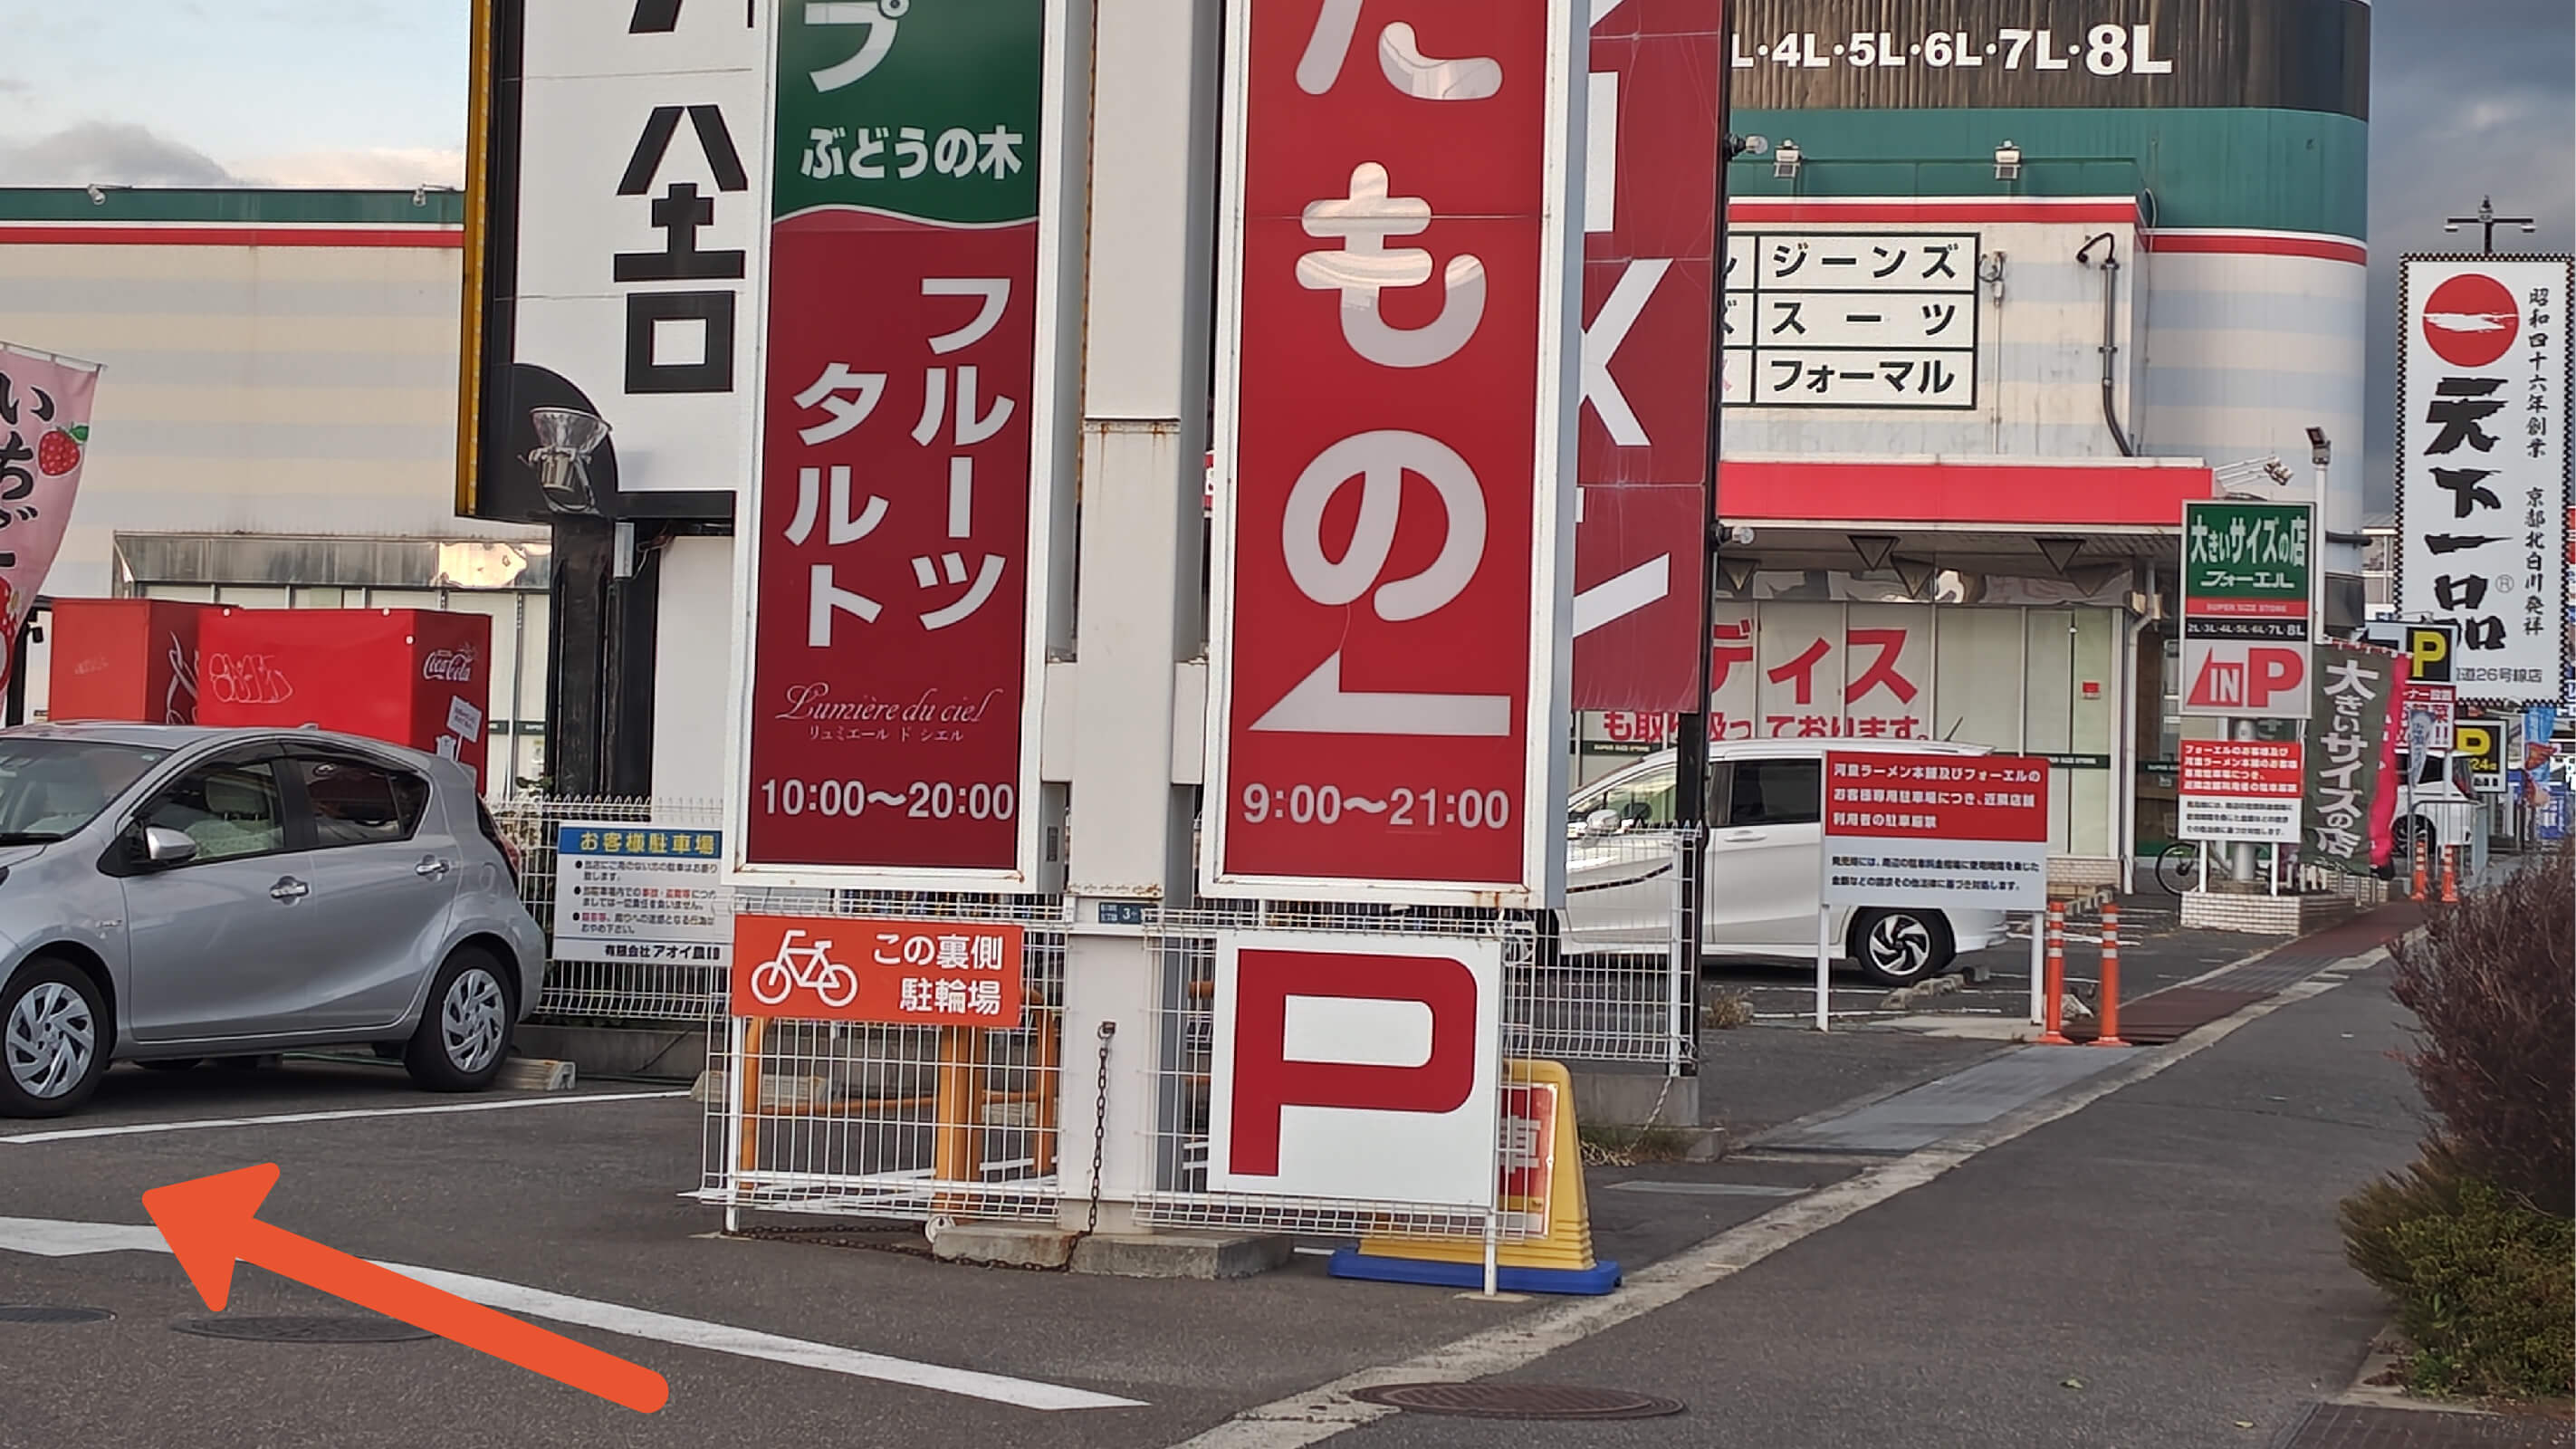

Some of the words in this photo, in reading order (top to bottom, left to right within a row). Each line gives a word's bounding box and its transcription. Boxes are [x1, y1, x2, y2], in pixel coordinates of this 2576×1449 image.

[800, 125, 1024, 179] ぶどうの木
[1772, 242, 1958, 279] ジーンズ
[1771, 302, 1957, 336] スーツ
[1771, 360, 1956, 394] フォーマル
[2524, 287, 2550, 459] 昭和四十六年創業
[911, 277, 1015, 632] フルーツ
[783, 362, 890, 648] タルト
[2190, 514, 2307, 569] 大きいサイズの店
[2523, 487, 2547, 637] 京都北白川発祥
[2200, 571, 2296, 589] フォーエル
[2411, 629, 2447, 677] P
[2210, 667, 2240, 703] IN
[2248, 647, 2304, 707] P
[2456, 667, 2543, 684] 道26号線店
[775, 682, 900, 721] Lumière
[902, 688, 938, 722] du
[941, 688, 1004, 723] ciel
[920, 728, 964, 743] シエル
[2314, 659, 2380, 859] 大きいサイズの店
[580, 830, 715, 855] お客様駐車場
[874, 933, 1004, 971] この裏側
[899, 977, 1002, 1016] 駐輪場
[1229, 947, 1479, 1177] P
